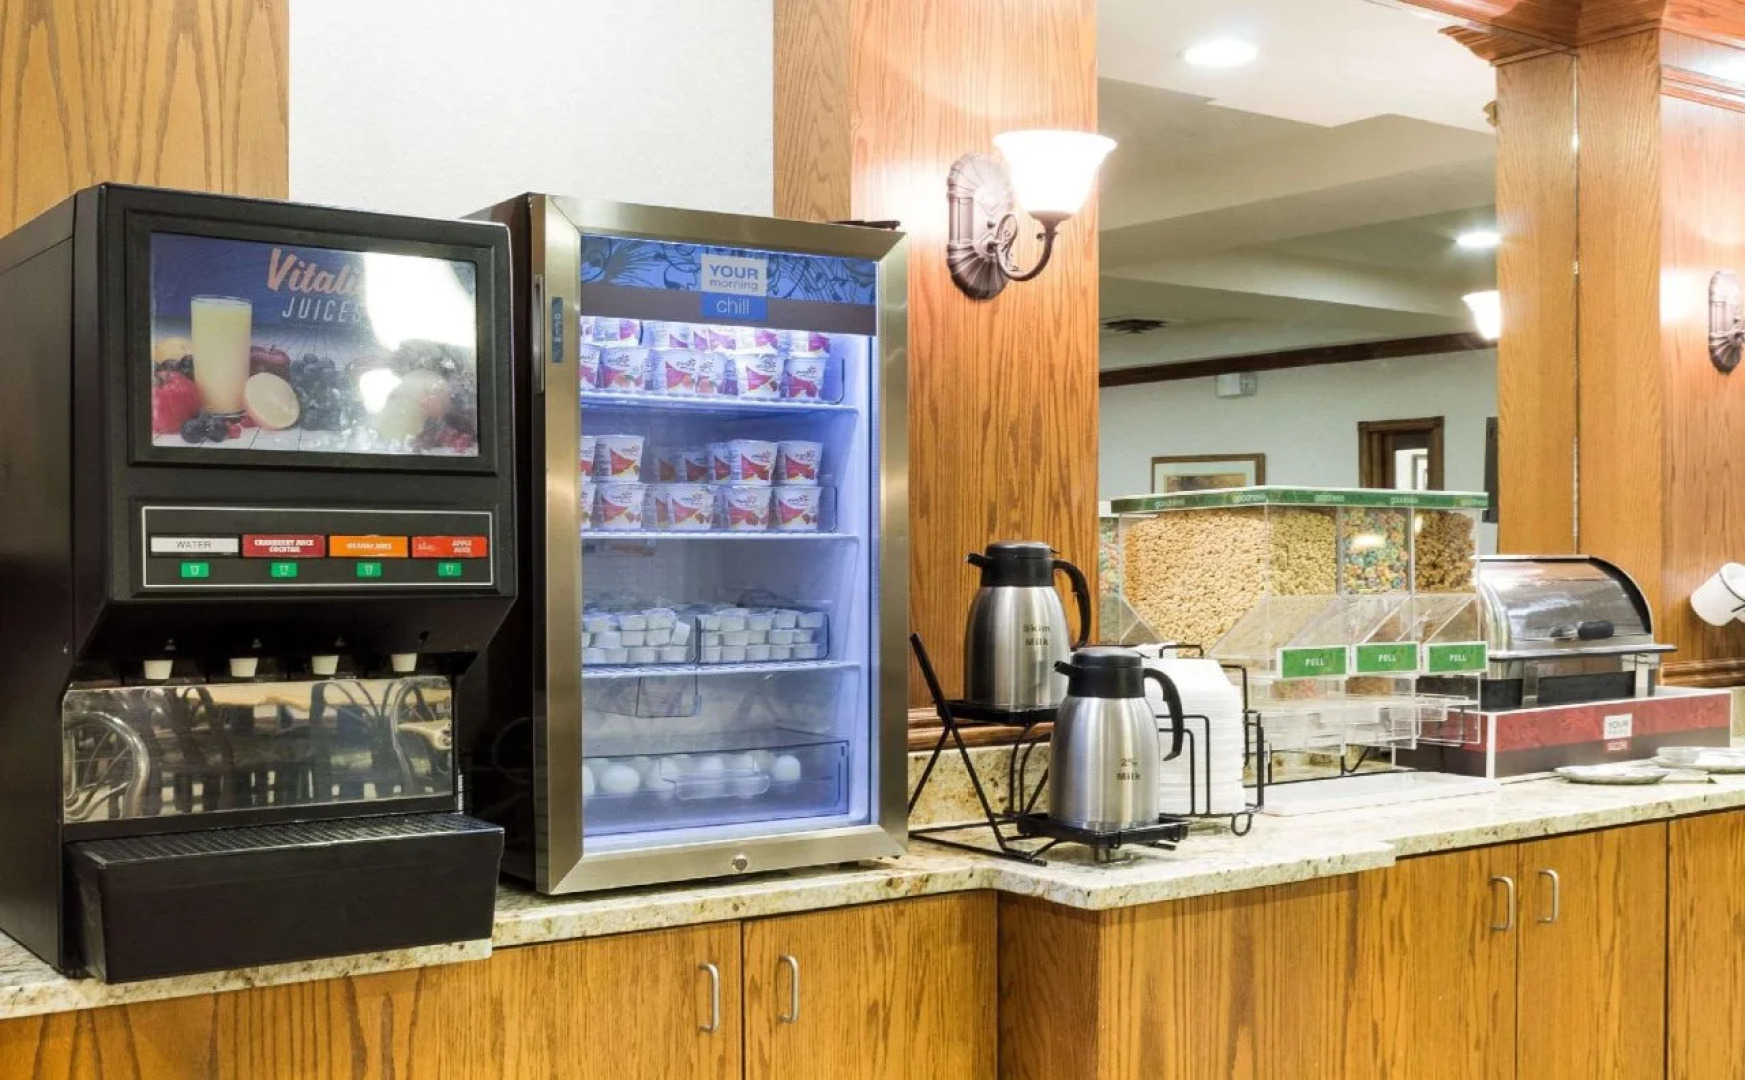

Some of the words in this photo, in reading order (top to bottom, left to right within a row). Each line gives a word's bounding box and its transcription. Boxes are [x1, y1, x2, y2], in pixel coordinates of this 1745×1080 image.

[709, 264, 759, 280] YOUR
[709, 279, 759, 293] morning
[282, 296, 361, 323] JUICES
[716, 296, 749, 315] chill
[175, 540, 211, 549] WATER
[1023, 624, 1050, 632] Skim
[1025, 637, 1049, 646] Milk
[1305, 657, 1325, 667] PULL
[1378, 653, 1397, 663] PULL
[1449, 653, 1467, 663] PULL
[1115, 772, 1141, 781] Milk
